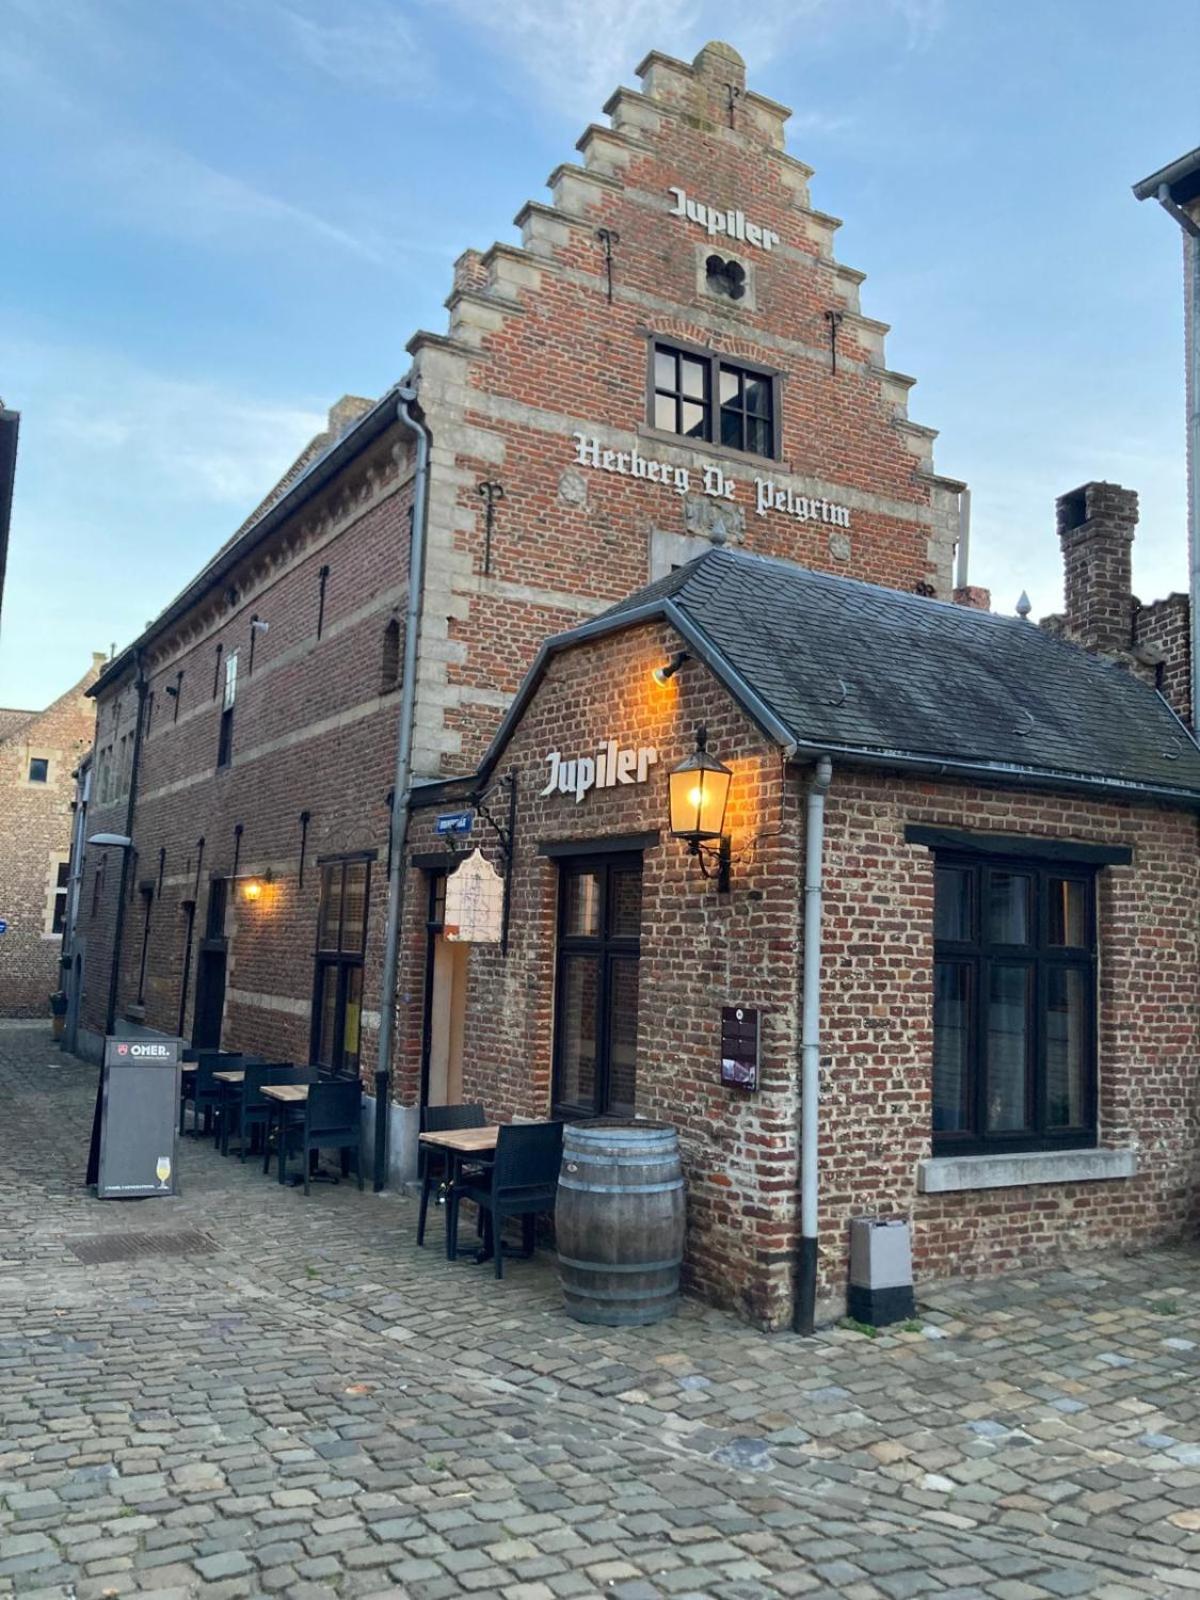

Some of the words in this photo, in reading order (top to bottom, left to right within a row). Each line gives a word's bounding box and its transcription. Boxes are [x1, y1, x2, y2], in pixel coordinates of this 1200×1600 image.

[668, 186, 780, 251] Jupiler
[572, 431, 689, 496] Herberg
[703, 464, 736, 500] De
[754, 476, 851, 528] Pelgrim
[540, 741, 658, 803] Jupiler
